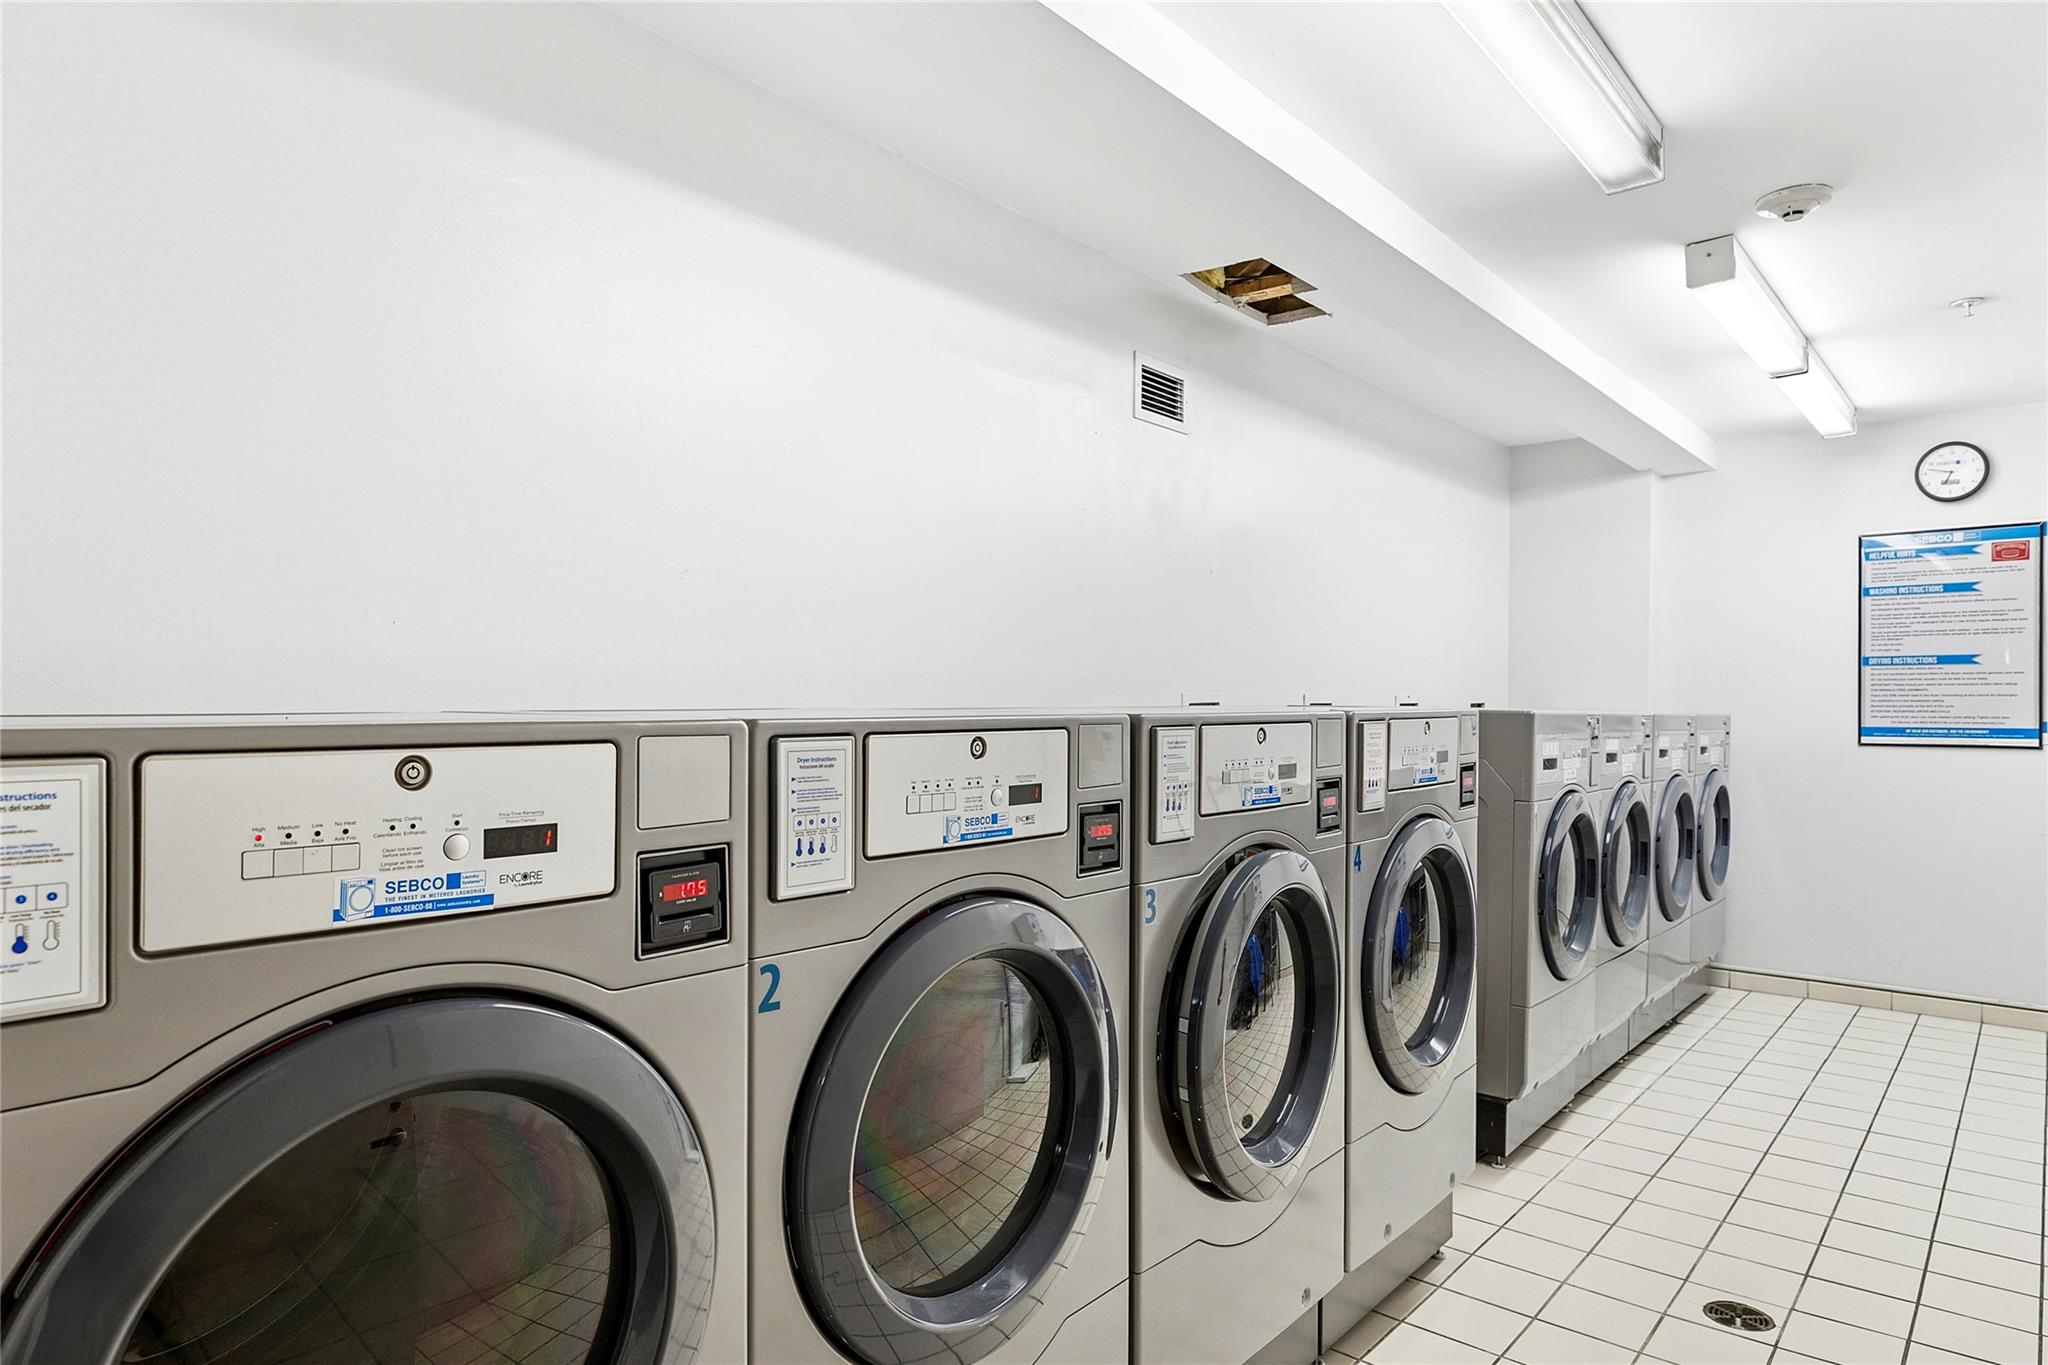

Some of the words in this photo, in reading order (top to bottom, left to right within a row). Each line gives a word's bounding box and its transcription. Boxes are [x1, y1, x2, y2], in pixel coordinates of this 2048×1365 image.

[1914, 534, 1953, 545] SEBCO
[1869, 551, 1896, 560] HELPFUL
[1896, 549, 1916, 559] HINTS
[1869, 587, 1898, 596] WASHING
[1898, 585, 1944, 595] INSTRUCTIONS
[1868, 657, 1892, 666] DRYING
[1893, 656, 1938, 665] INSTRUCTIONS
[9, 803, 21, 812] del
[22, 802, 52, 812] secador
[965, 815, 991, 827] SEBCO
[1353, 844, 1362, 872] 4
[499, 869, 543, 885] ENCORE
[384, 876, 445, 895] SEBCO
[398, 894, 418, 902] FINEST
[429, 891, 454, 899] METERED
[456, 888, 486, 896] LAUNDRIES
[1144, 888, 1157, 925] 3
[758, 963, 781, 1013] 2
